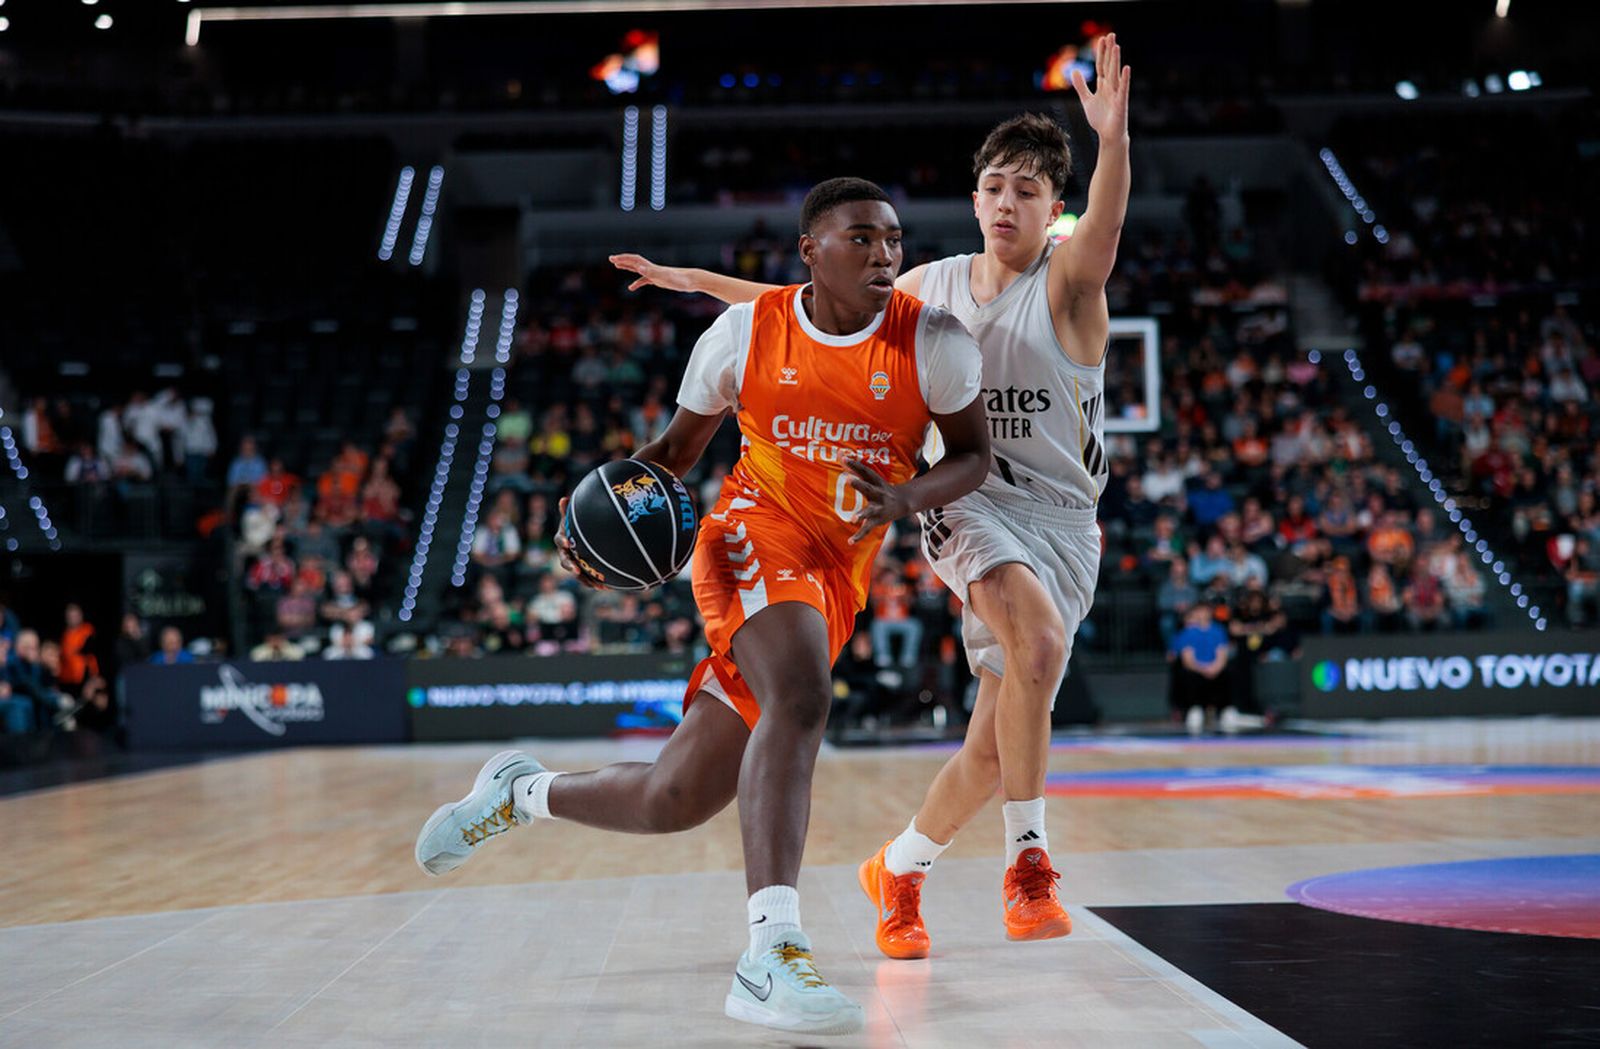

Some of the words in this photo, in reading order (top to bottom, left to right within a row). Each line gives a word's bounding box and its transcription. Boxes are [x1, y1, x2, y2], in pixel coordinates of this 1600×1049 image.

[981, 385, 1051, 414] ates
[772, 415, 870, 442] Cultura
[986, 416, 1032, 439] TTER
[1345, 657, 1472, 691] NUEVO
